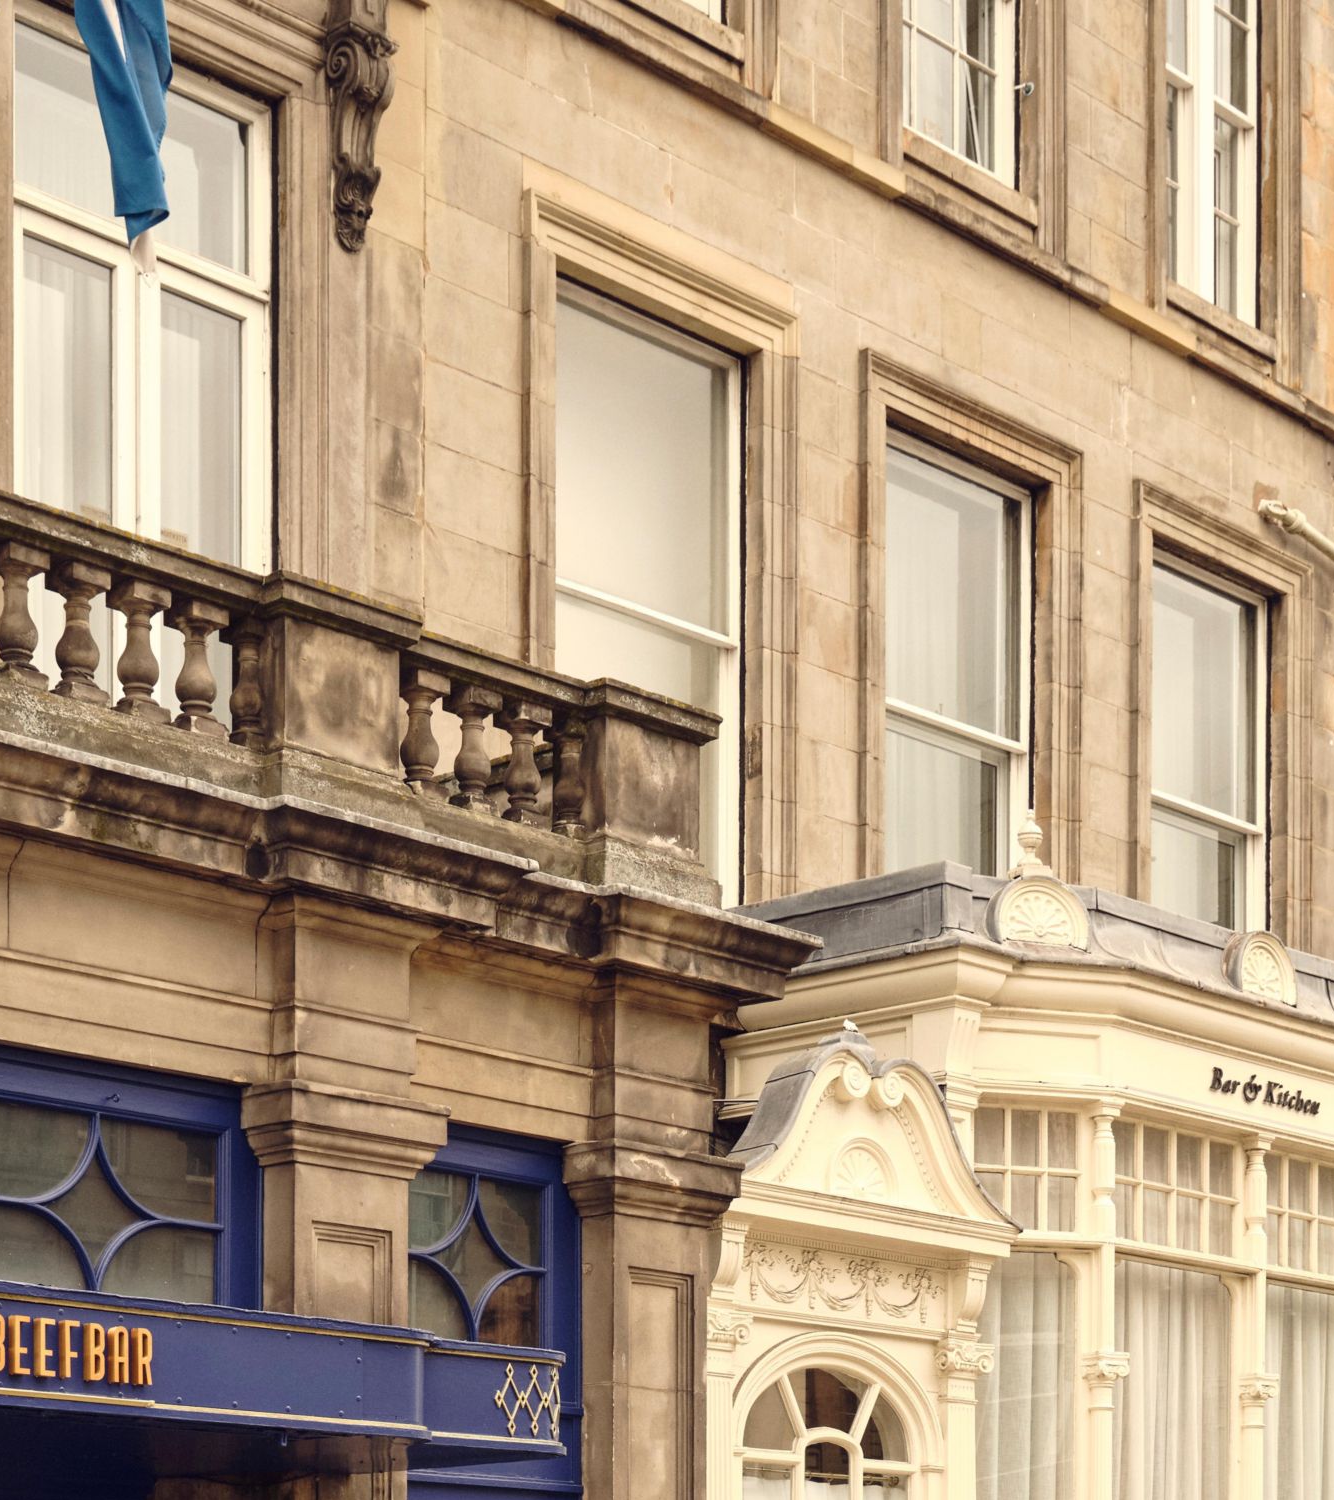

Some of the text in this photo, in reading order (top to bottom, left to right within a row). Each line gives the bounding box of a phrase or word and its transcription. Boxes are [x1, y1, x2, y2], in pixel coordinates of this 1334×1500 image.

[1209, 1066, 1321, 1115] Bar & Kitchen
